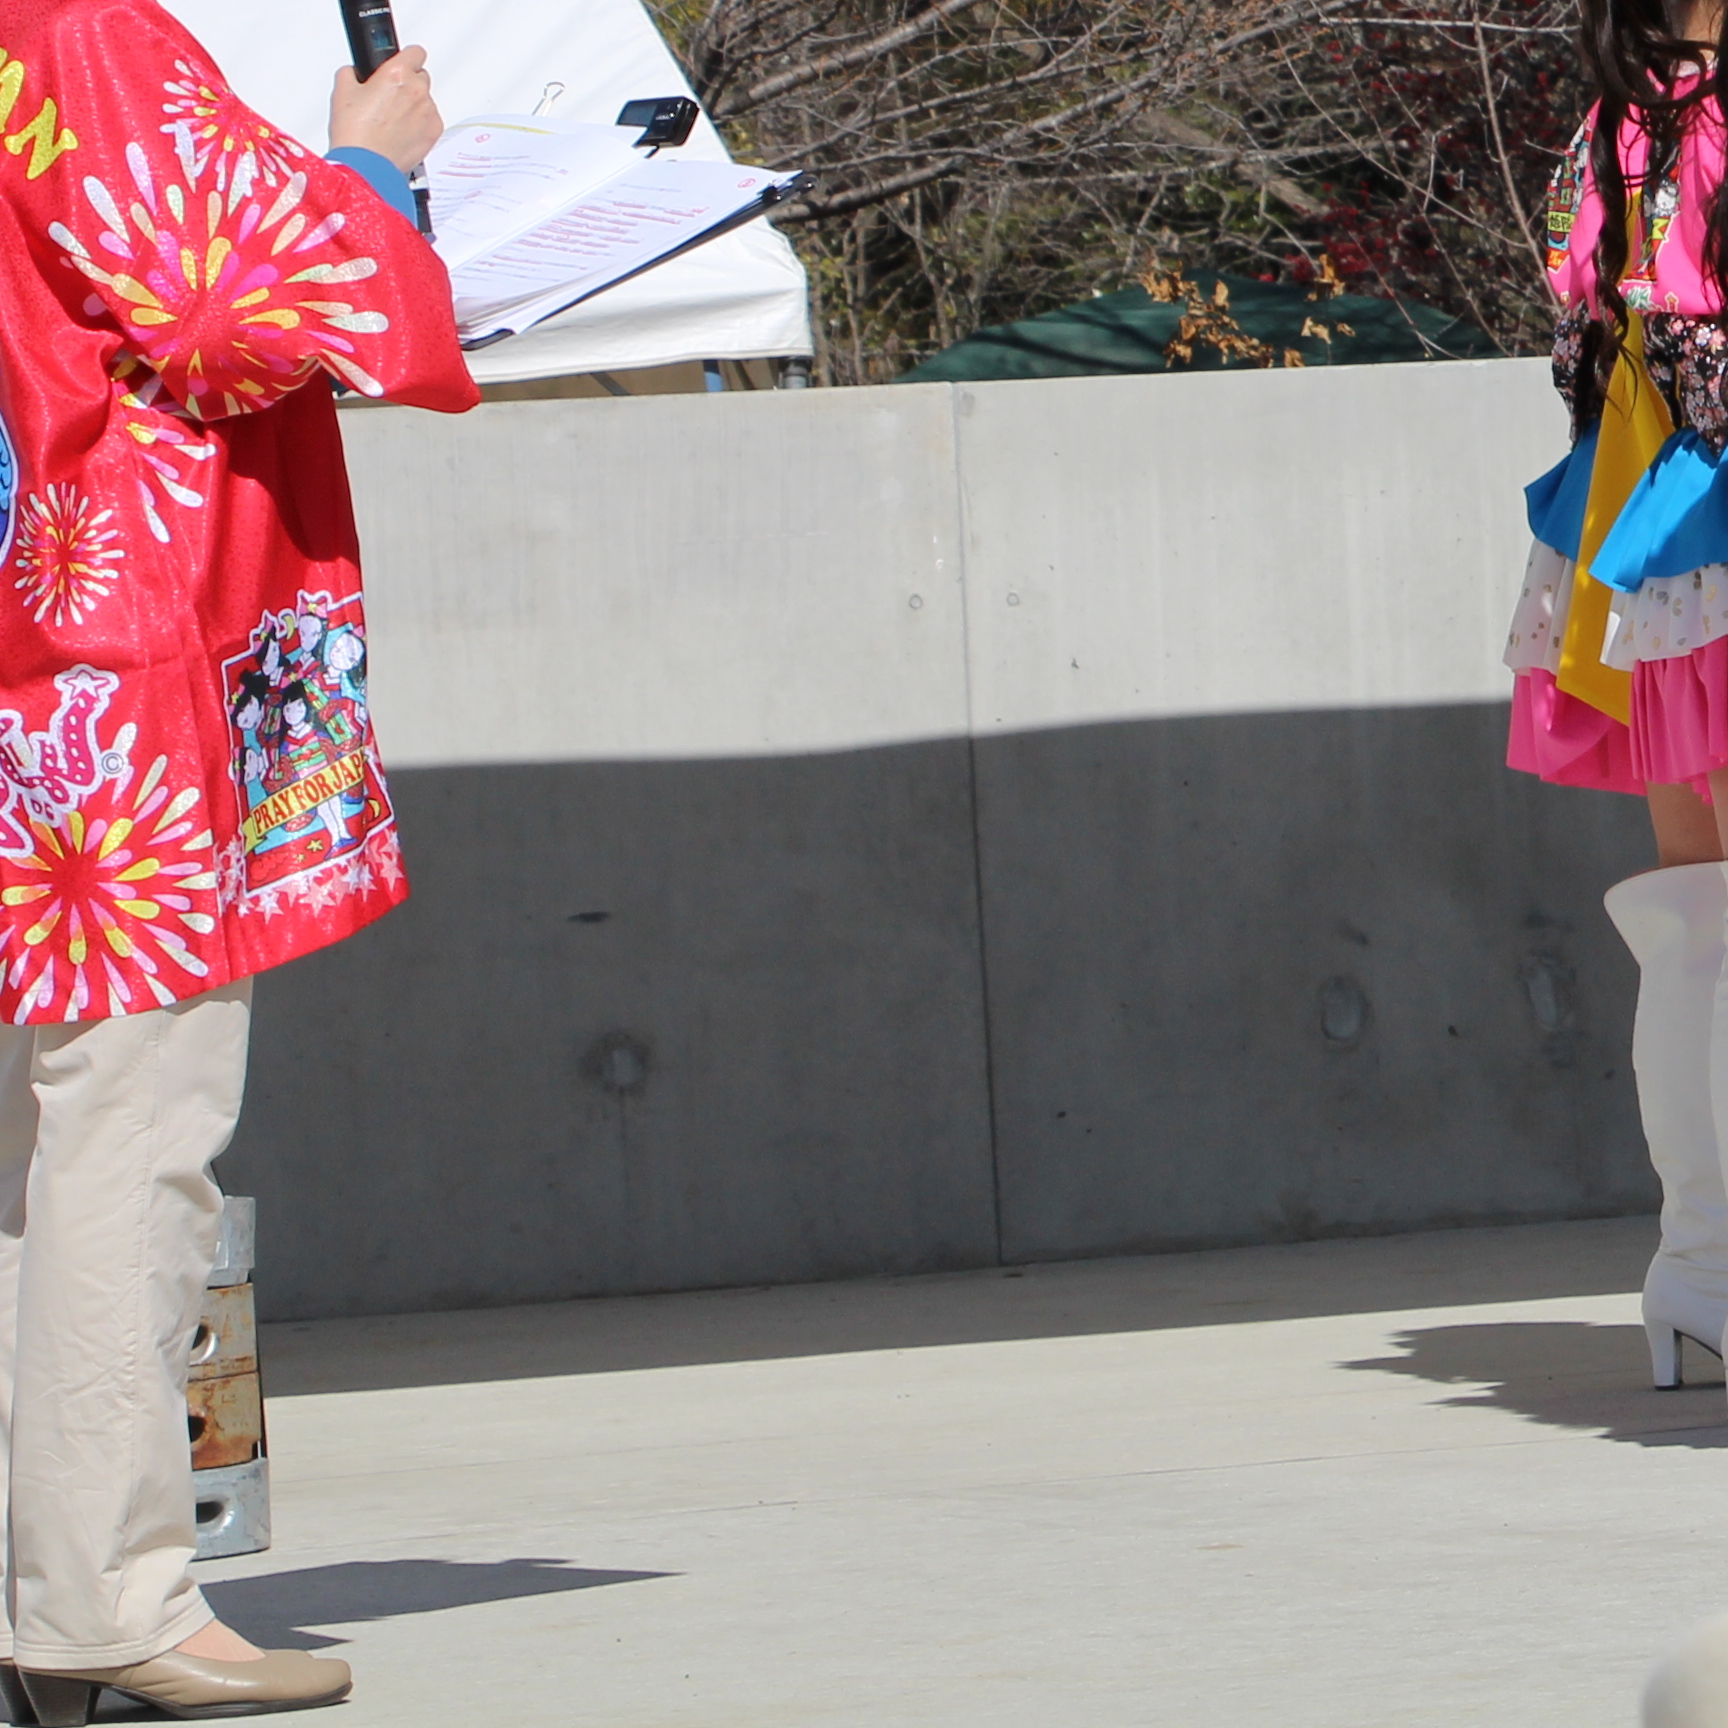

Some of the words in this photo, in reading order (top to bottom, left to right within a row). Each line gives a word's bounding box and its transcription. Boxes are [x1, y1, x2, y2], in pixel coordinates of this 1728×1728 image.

[252, 788, 294, 835] PRAY
[292, 771, 335, 812] FOR
[330, 750, 364, 791] JAP
